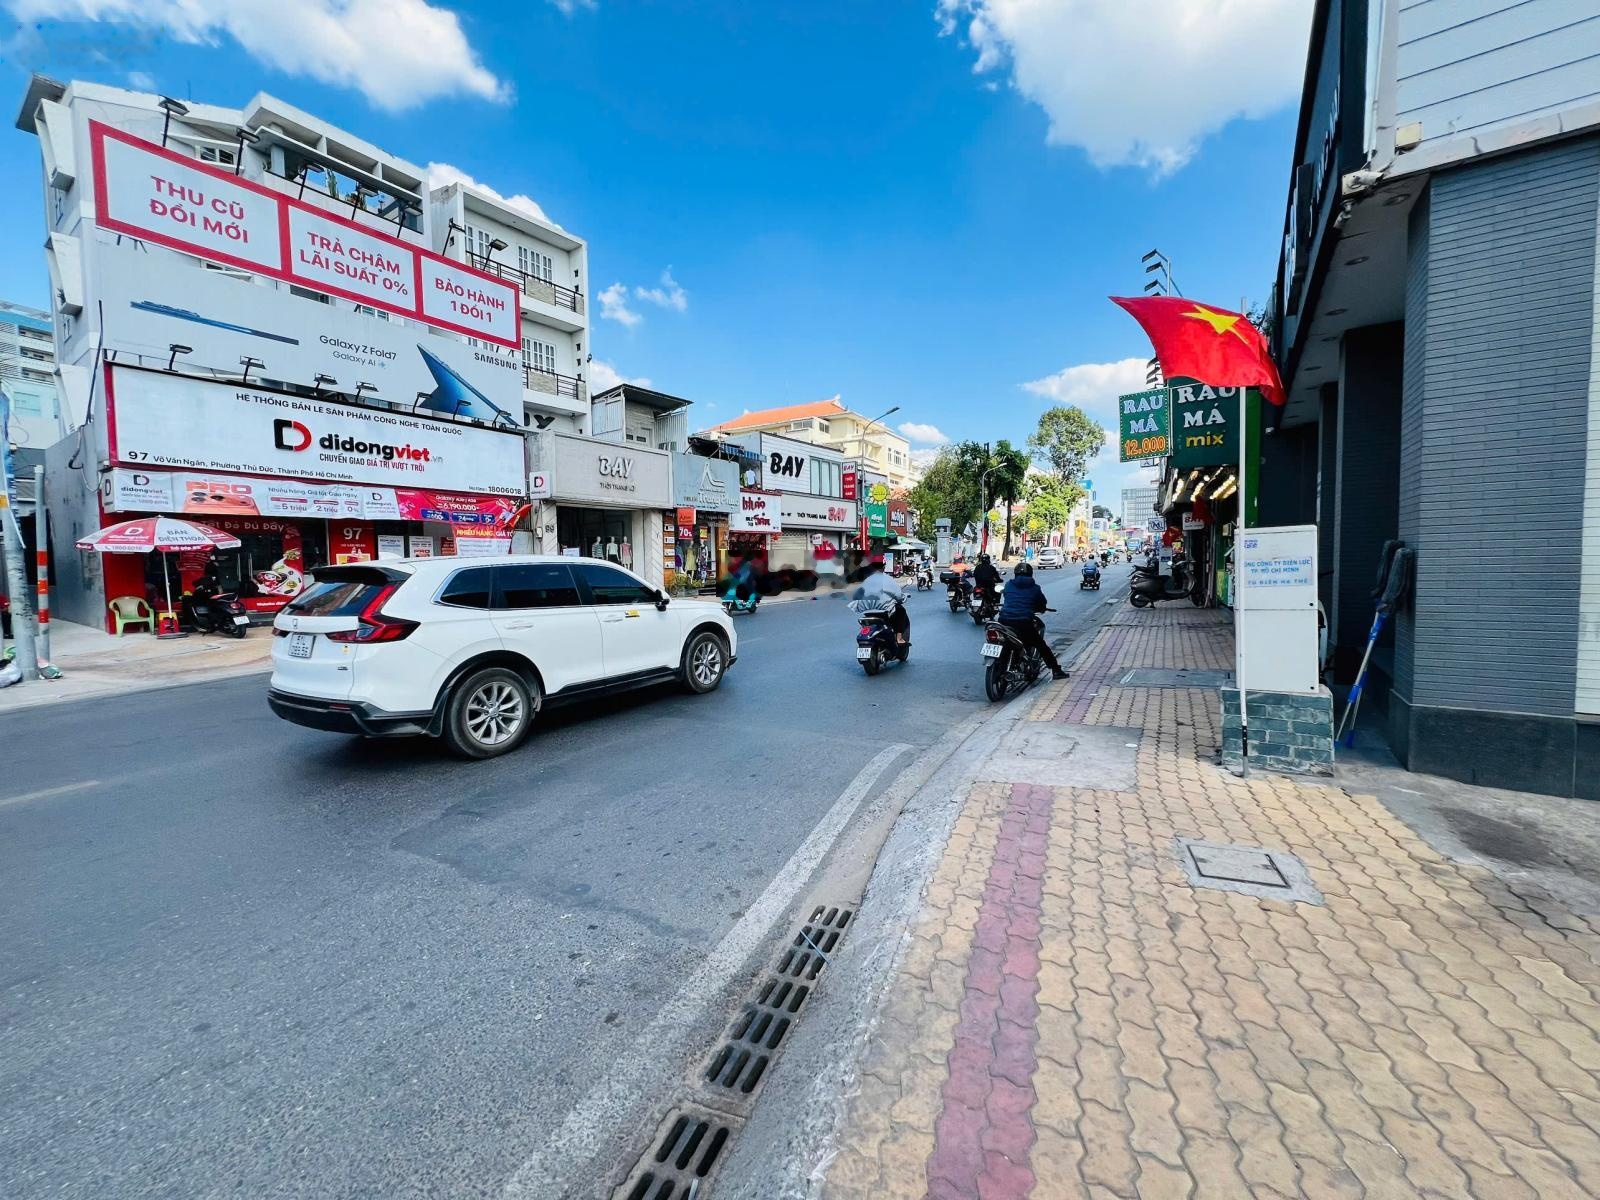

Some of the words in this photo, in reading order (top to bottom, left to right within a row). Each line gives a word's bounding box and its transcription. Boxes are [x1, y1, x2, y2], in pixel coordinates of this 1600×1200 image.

[150, 176, 204, 206] THU
[212, 198, 244, 220] CŨ
[150, 198, 196, 226] ĐỔI
[202, 216, 248, 243] MỚI
[307, 232, 344, 256] TRẢ
[348, 248, 400, 275] CHẬM
[300, 249, 330, 270] LÃI
[334, 261, 378, 285] SUẤT
[382, 278, 408, 296] 0%
[435, 278, 464, 296] BẢO
[467, 289, 504, 311] HÀNH
[450, 300, 456, 311] 1
[486, 312, 492, 322] 1
[319, 335, 360, 353] Galaxy
[362, 345, 368, 354] Z
[370, 347, 396, 360] Fold7
[332, 350, 366, 366] Galaxy
[474, 352, 517, 370] SAMSUNG
[1123, 394, 1164, 414] RAU
[1177, 384, 1236, 404] RAU
[1130, 413, 1159, 434] MÁ
[1183, 403, 1226, 428] MÁ
[320, 434, 443, 463] didongviet.vn
[1124, 436, 1166, 456] 12.000
[1186, 431, 1224, 447] mix
[128, 451, 148, 460] 97
[349, 456, 364, 466] GIAO
[380, 460, 390, 470] TRỊ
[770, 452, 804, 478] BAY
[598, 455, 633, 479] BAY
[488, 486, 522, 495] 18006018
[828, 506, 847, 522] BAY
[244, 521, 258, 529] Đủ
[344, 528, 362, 540] 97
